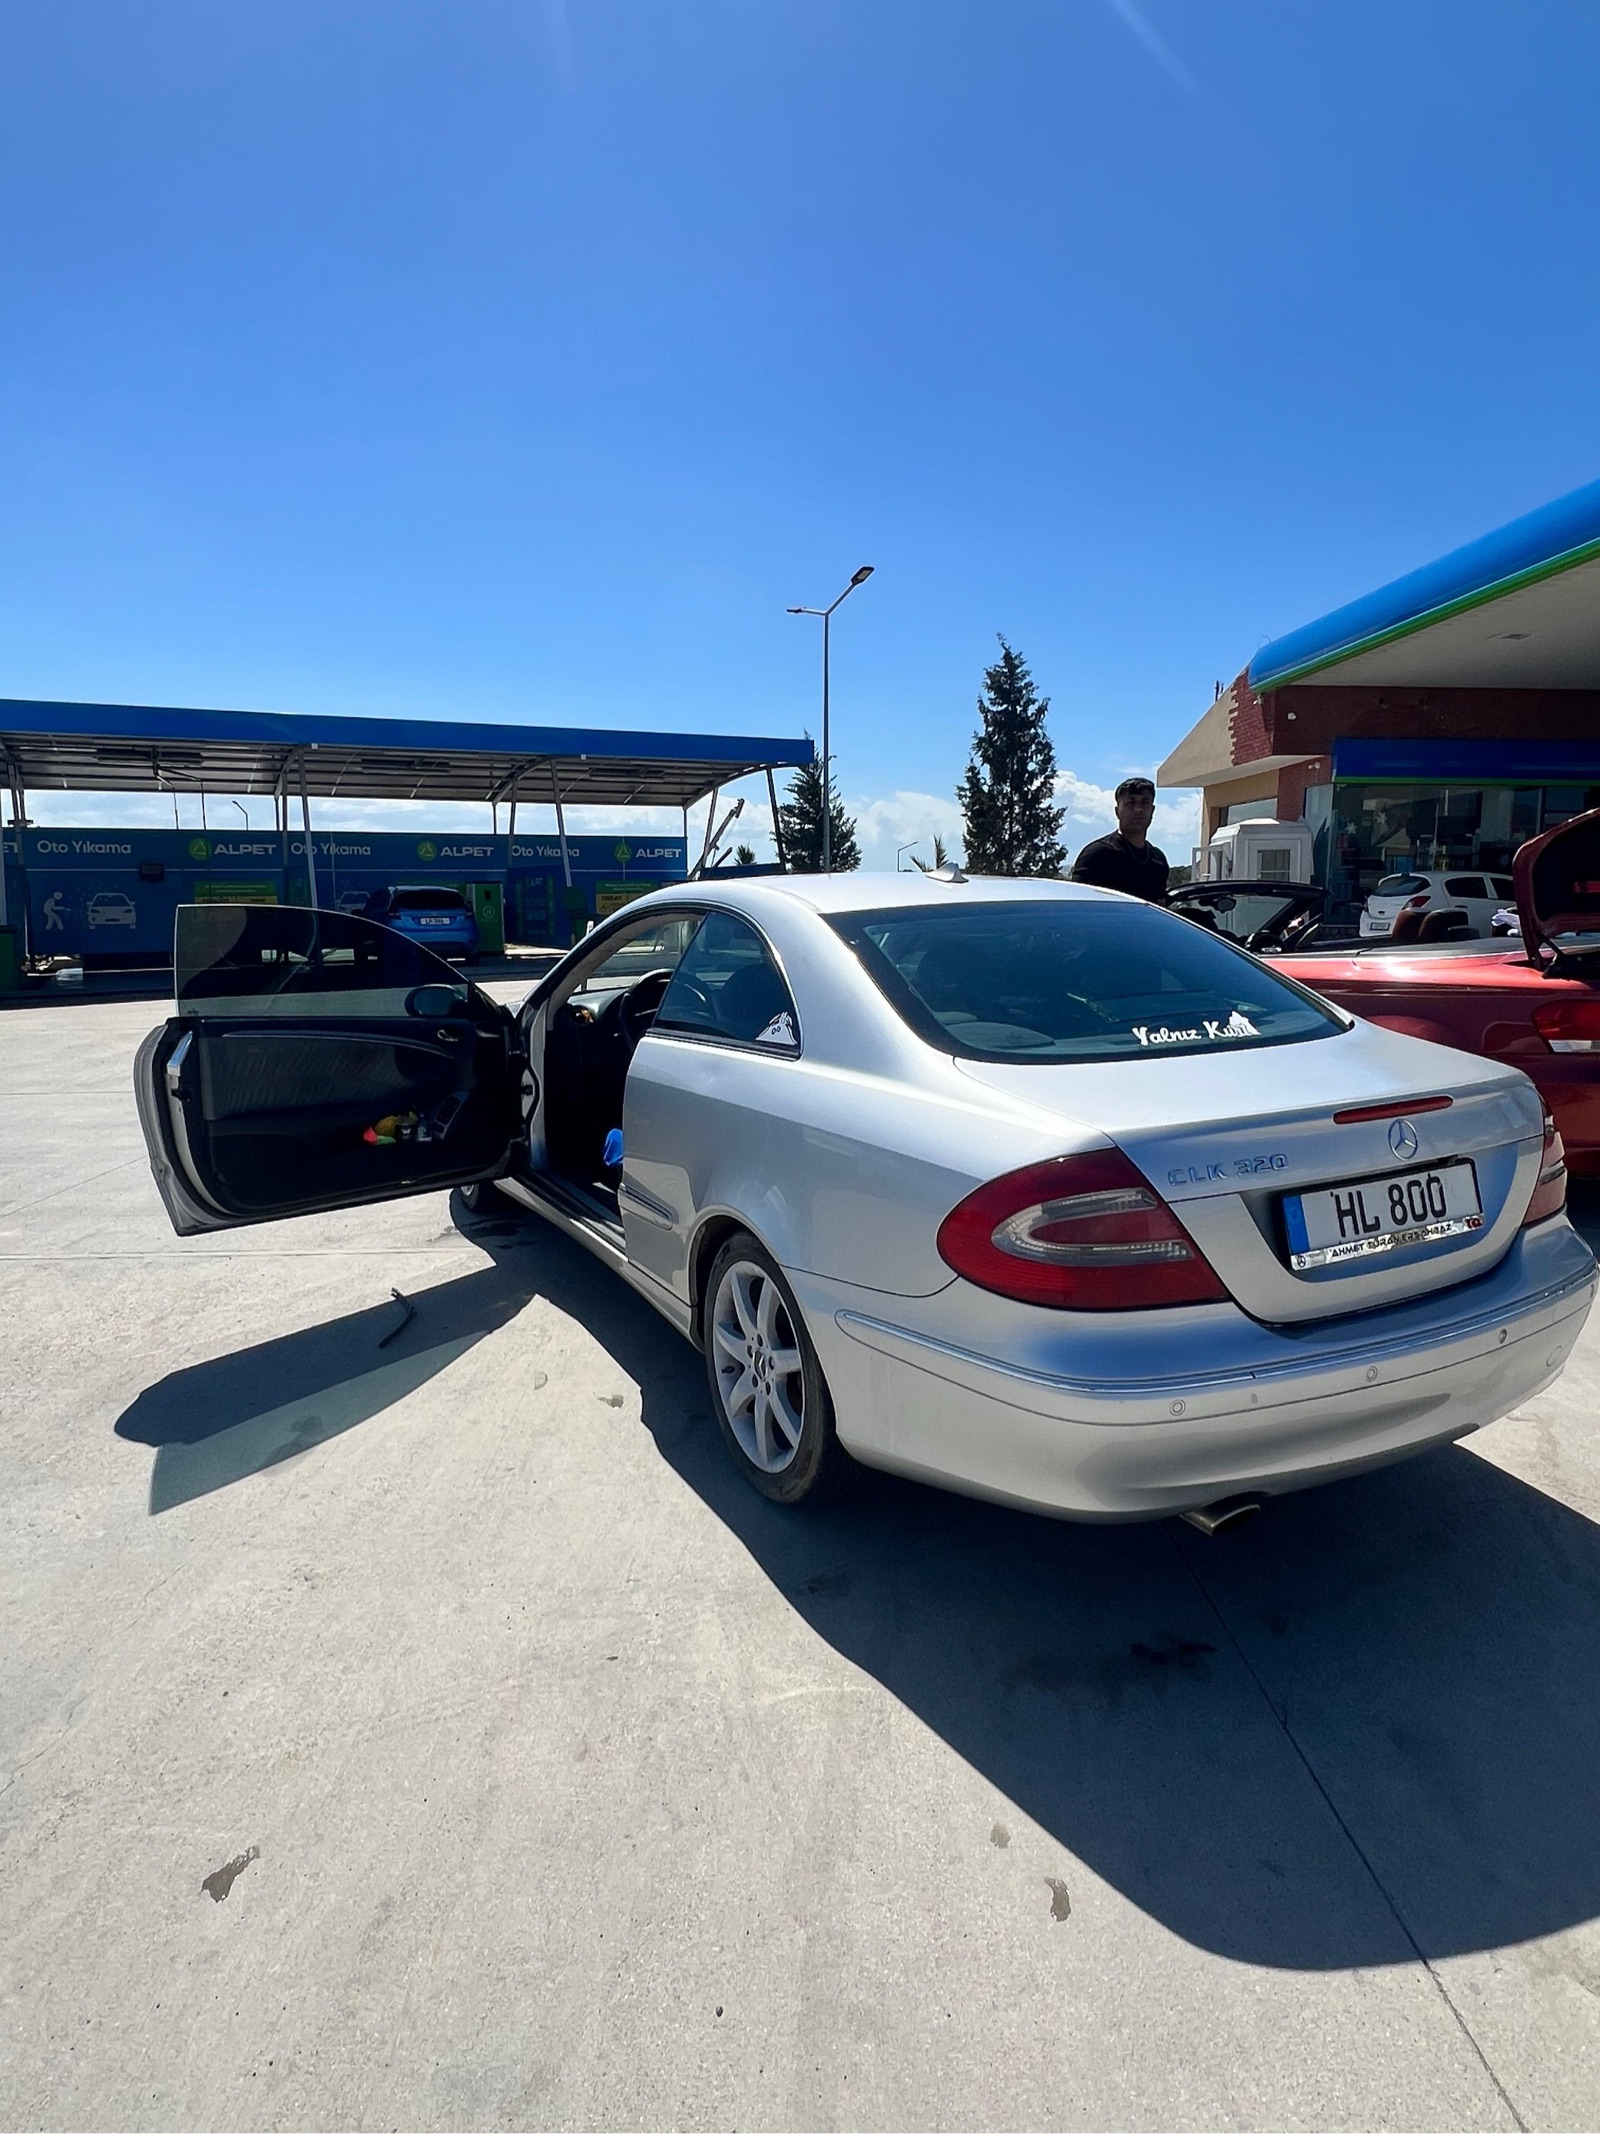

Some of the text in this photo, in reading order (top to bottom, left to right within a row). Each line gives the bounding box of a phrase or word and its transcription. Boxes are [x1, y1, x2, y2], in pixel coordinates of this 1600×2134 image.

[37, 840, 132, 854] Oto Yıkama
[214, 843, 276, 855] ALPET
[320, 842, 371, 856] Yıkama
[440, 846, 494, 857] ALPET
[512, 845, 534, 857] Oto
[635, 848, 682, 858] ALPET
[1168, 1153, 1289, 1187] CLK 320
[1334, 1175, 1447, 1238] HL 800
[1331, 1243, 1364, 1257] AHMET
